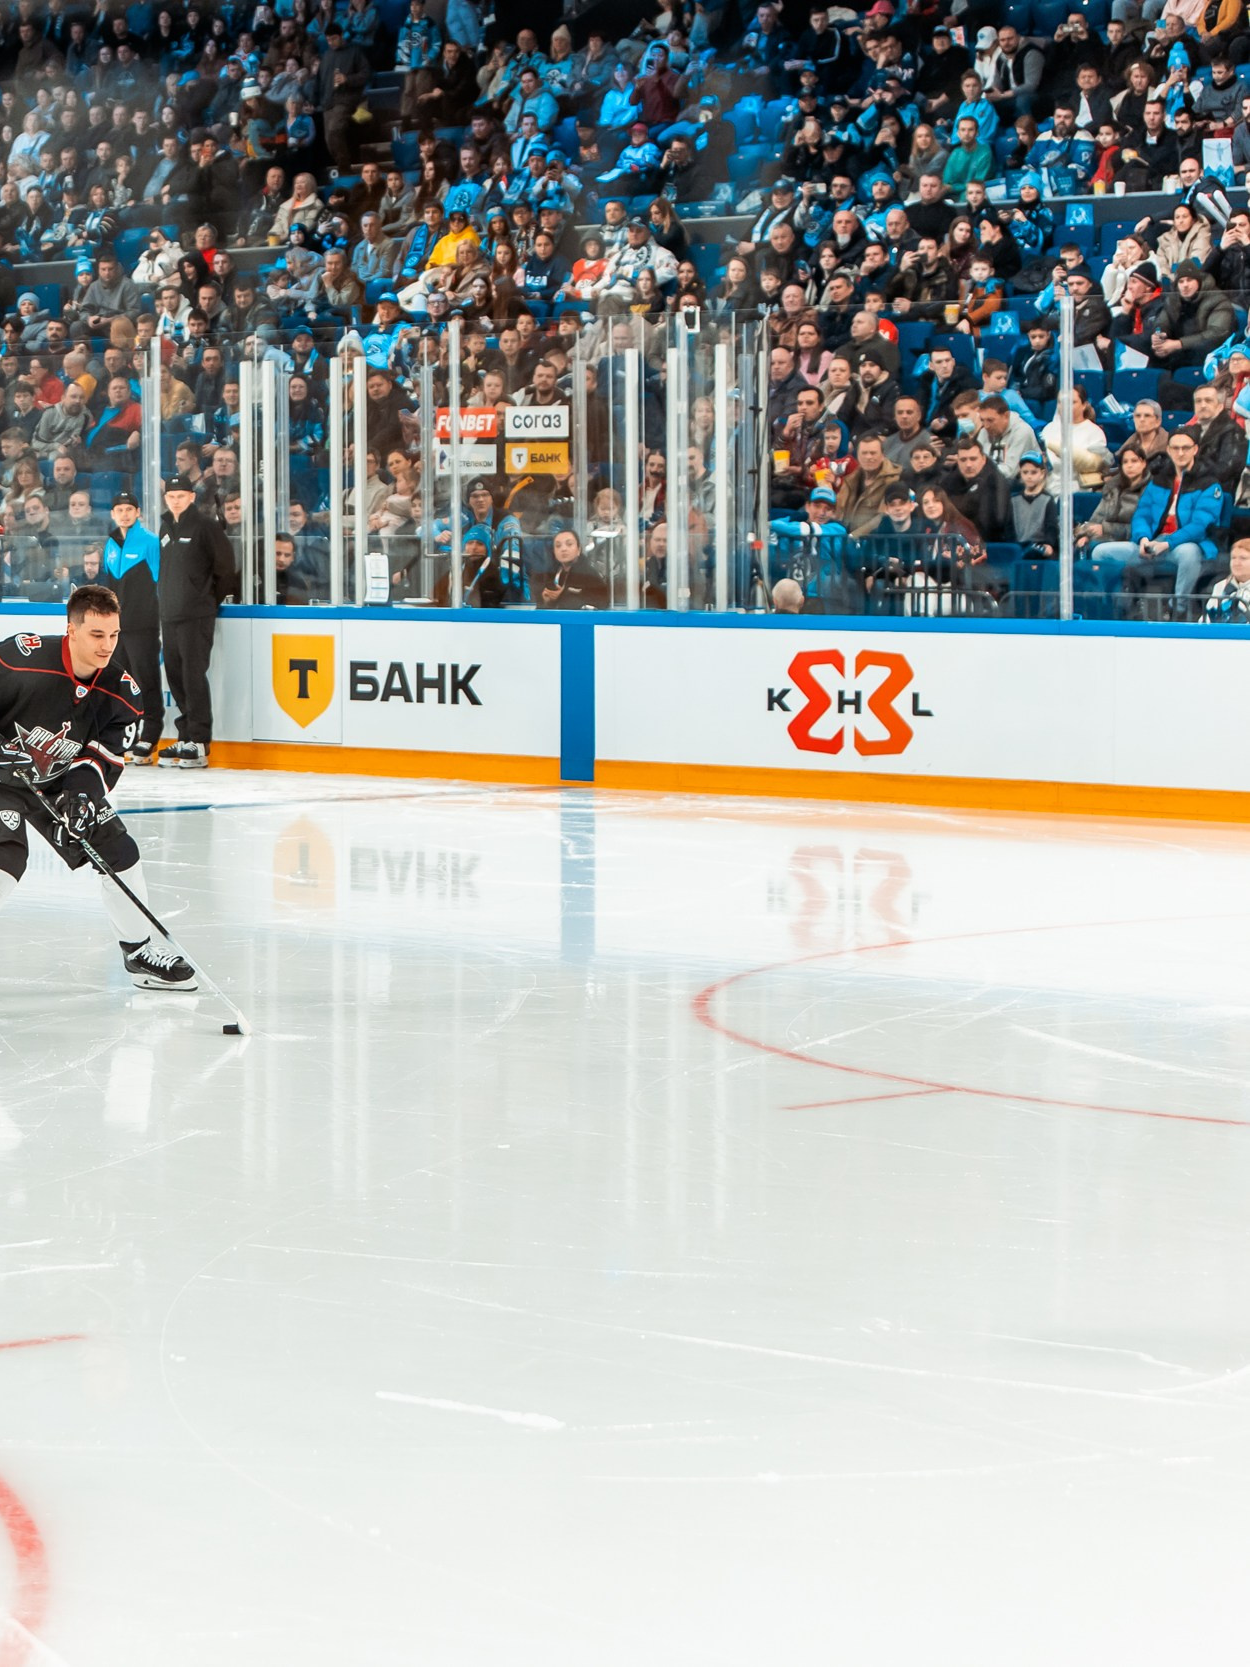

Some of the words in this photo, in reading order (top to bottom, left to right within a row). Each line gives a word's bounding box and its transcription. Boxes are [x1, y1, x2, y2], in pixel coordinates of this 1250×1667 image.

[530, 453, 561, 463] БАНК
[349, 660, 483, 706] БАНК
[46, 738, 82, 760] STAR
